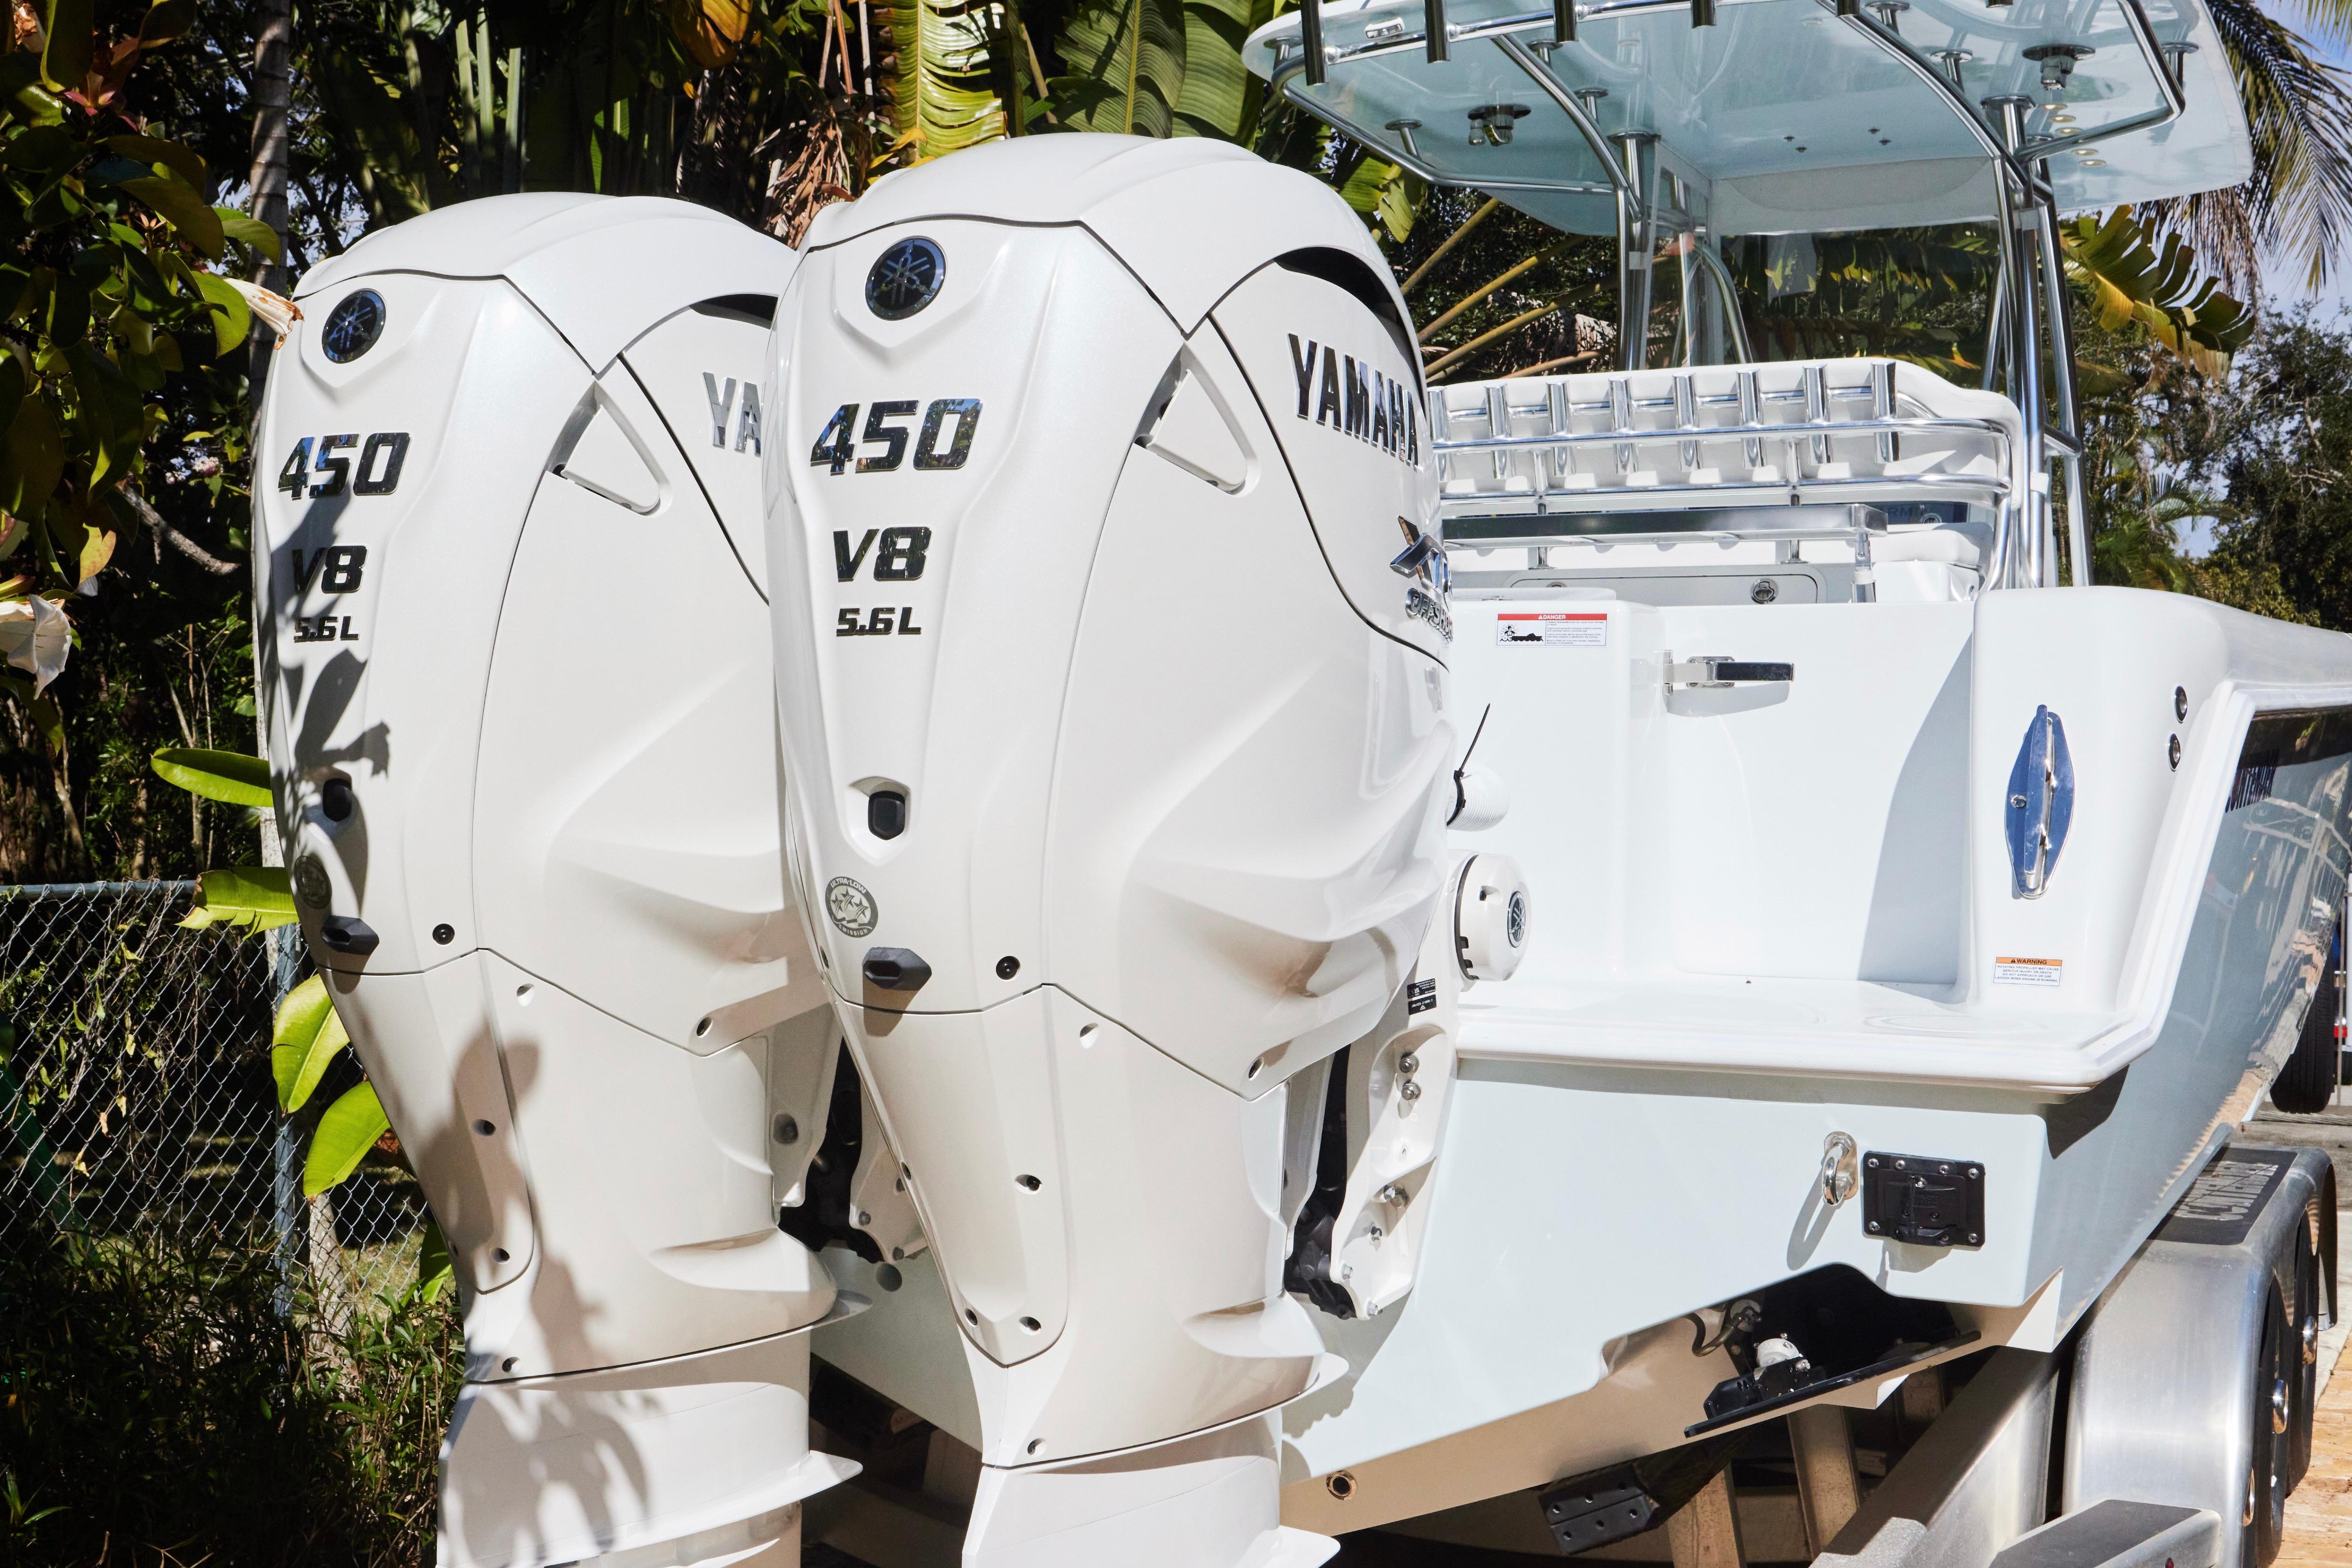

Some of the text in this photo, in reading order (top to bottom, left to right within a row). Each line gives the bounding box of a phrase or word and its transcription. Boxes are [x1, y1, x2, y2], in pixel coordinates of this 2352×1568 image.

[702, 371, 762, 458] YA
[1287, 332, 1422, 472] YAMAHA
[810, 398, 983, 476] 450
[278, 432, 412, 500] 450
[292, 545, 368, 594] V8
[833, 526, 932, 582] V8
[293, 615, 360, 643] 5.6L
[836, 606, 922, 637] 5.6L
[1406, 587, 1454, 641] OFFSHOR
[837, 923, 868, 936] EMISSION
